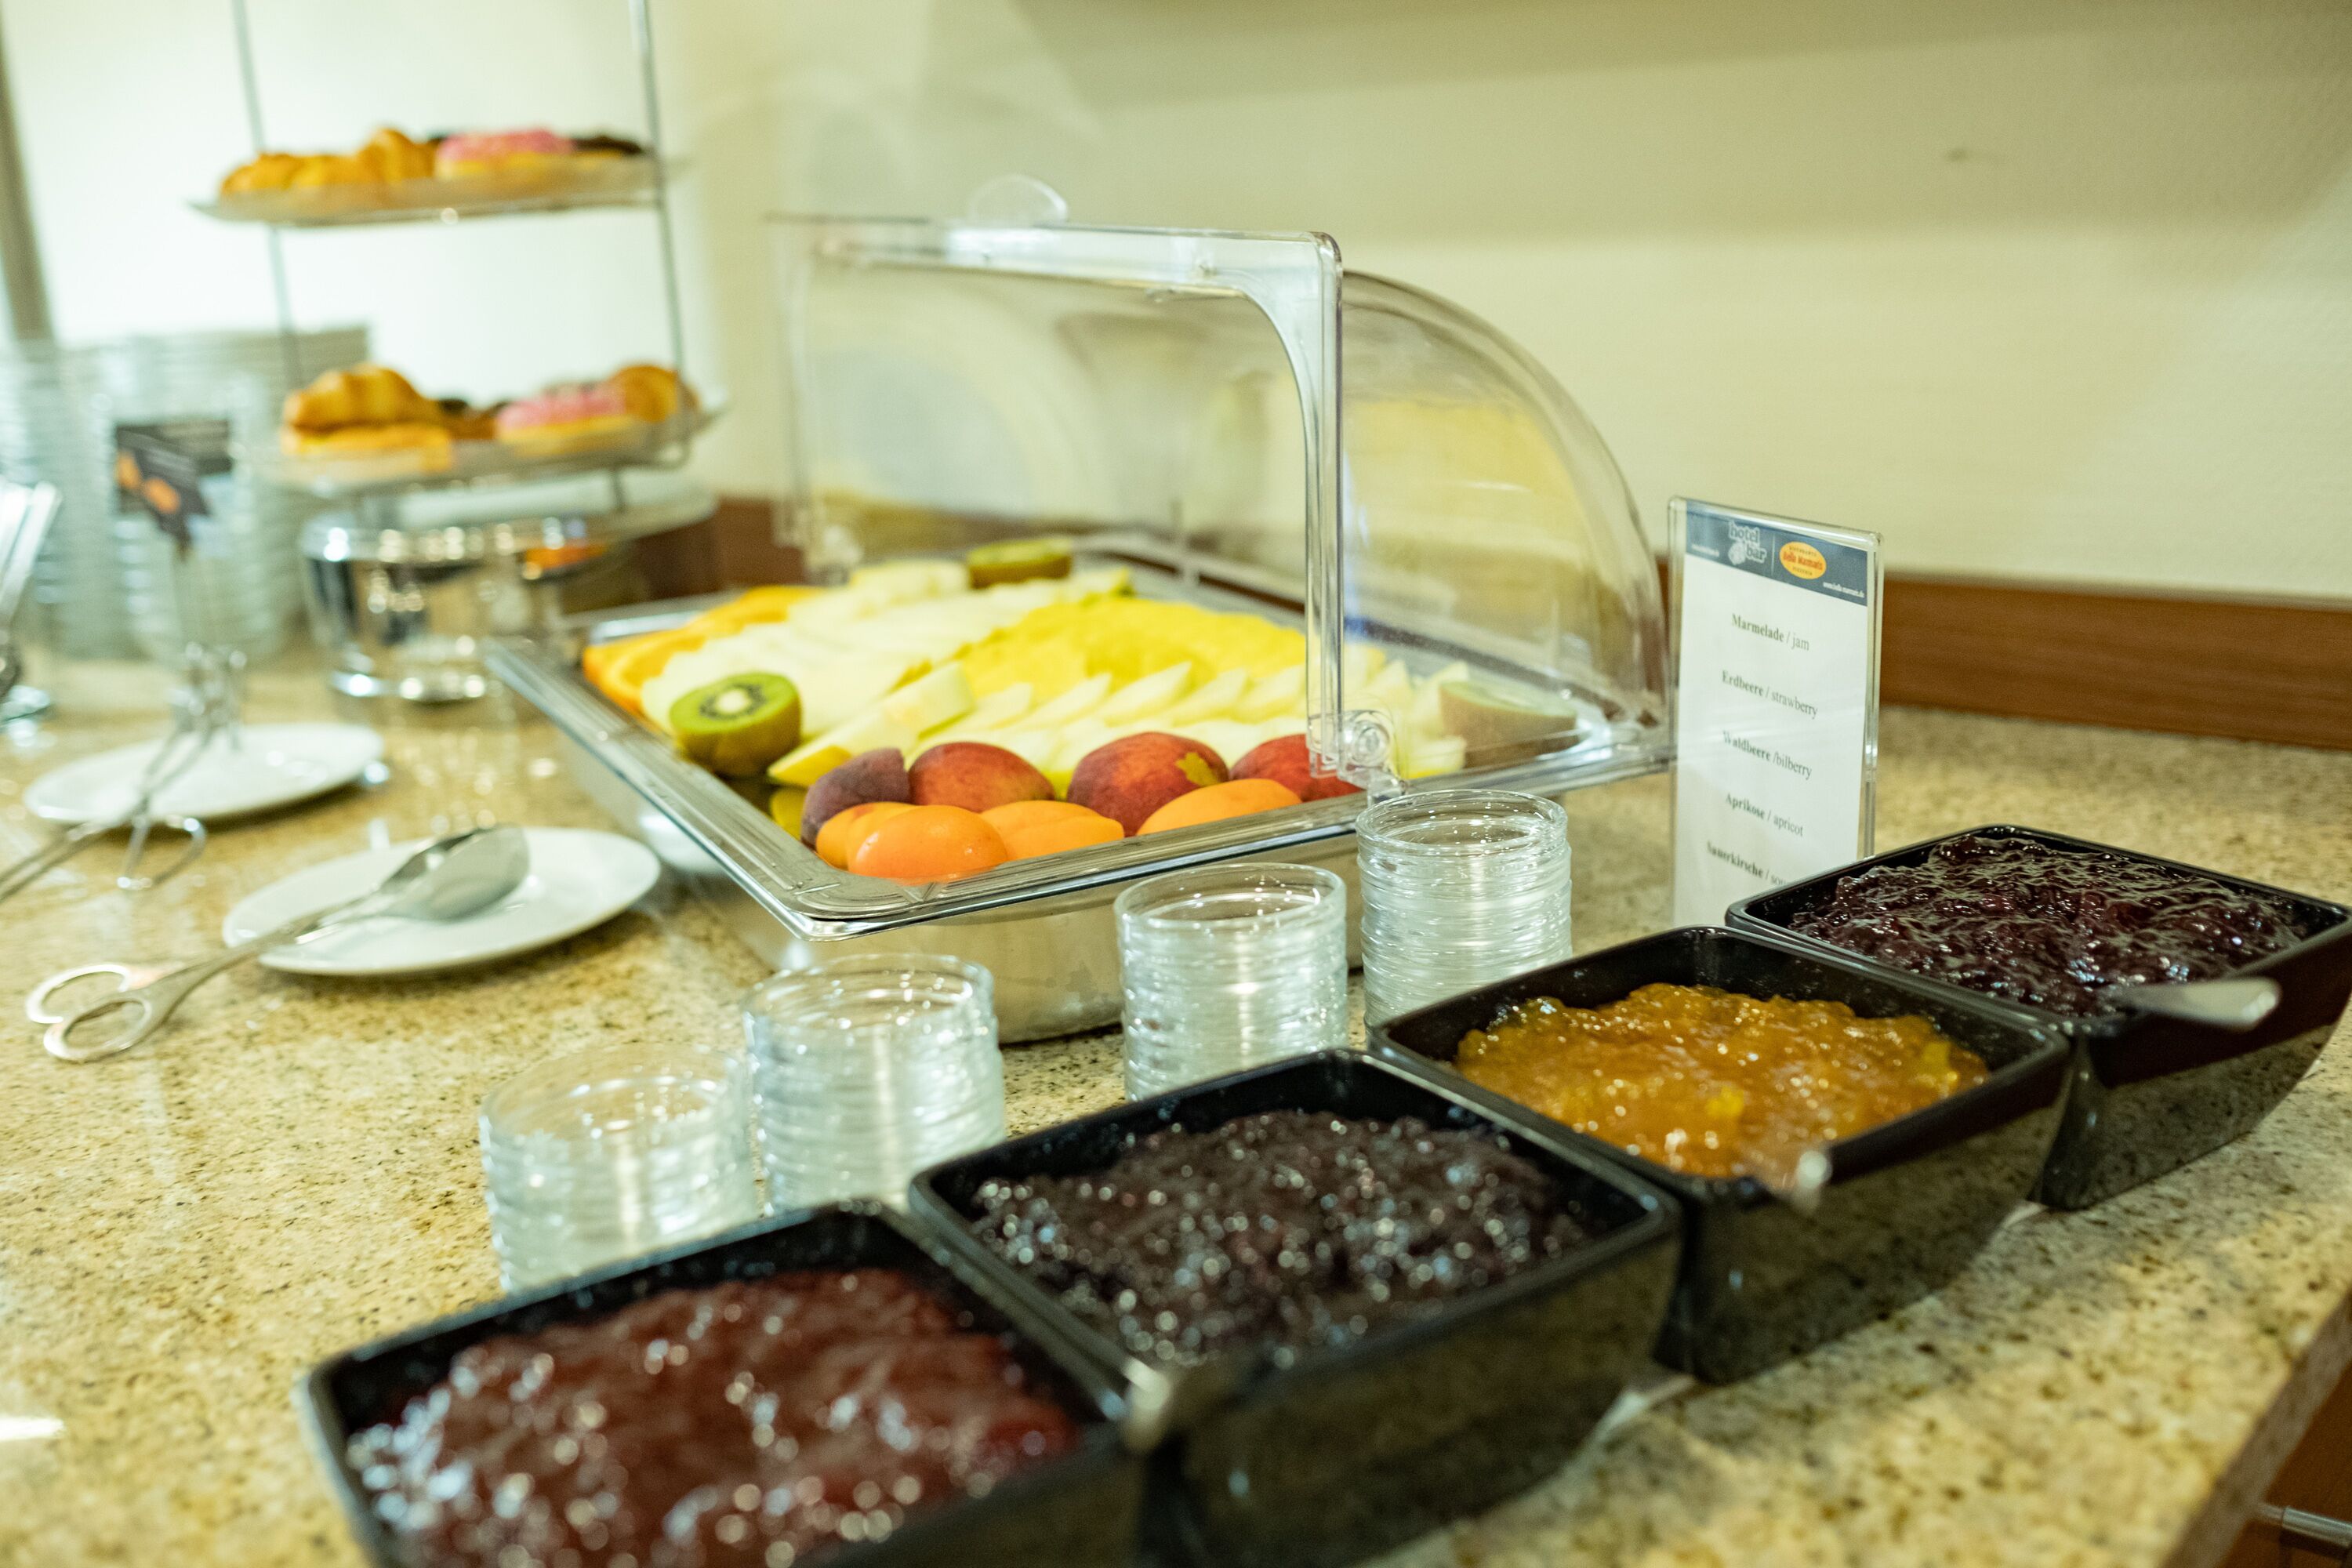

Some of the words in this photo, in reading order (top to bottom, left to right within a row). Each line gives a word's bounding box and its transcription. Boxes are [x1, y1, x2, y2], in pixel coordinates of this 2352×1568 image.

[1746, 543, 1766, 561] bar
[1731, 613, 1784, 643] Marmelade
[1786, 632, 1791, 644] /
[1791, 633, 1809, 651] jam
[1722, 670, 1764, 697] Erdbeere
[1765, 687, 1769, 699] /
[1771, 691, 1818, 720] strawberry
[1722, 730, 1770, 762] Waldbeere
[1725, 793, 1765, 818] Aprikose
[1767, 809, 1771, 822] /
[1773, 814, 1803, 837] apricot
[1707, 840, 1764, 877] Sauerkirsche
[1765, 869, 1769, 880] /
